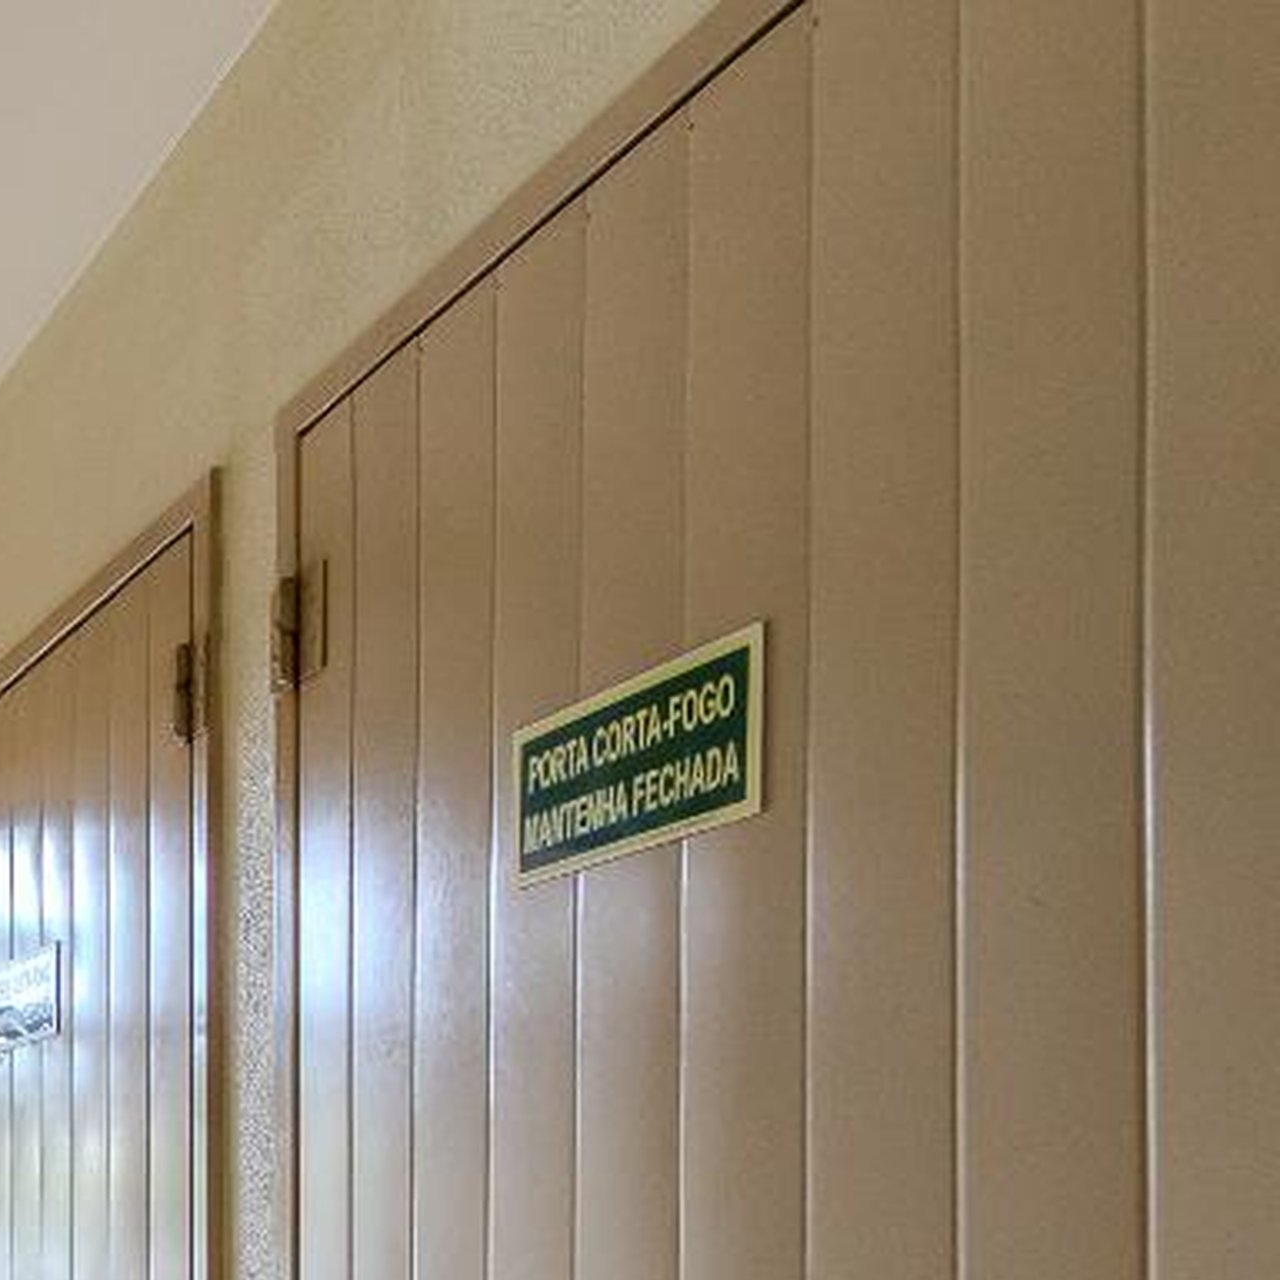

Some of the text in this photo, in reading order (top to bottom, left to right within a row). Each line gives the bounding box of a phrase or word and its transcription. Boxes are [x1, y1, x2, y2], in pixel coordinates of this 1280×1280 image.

[528, 674, 736, 794] PORTA CORTA-FOGO
[523, 740, 740, 854] MANTENHA FECHADA
